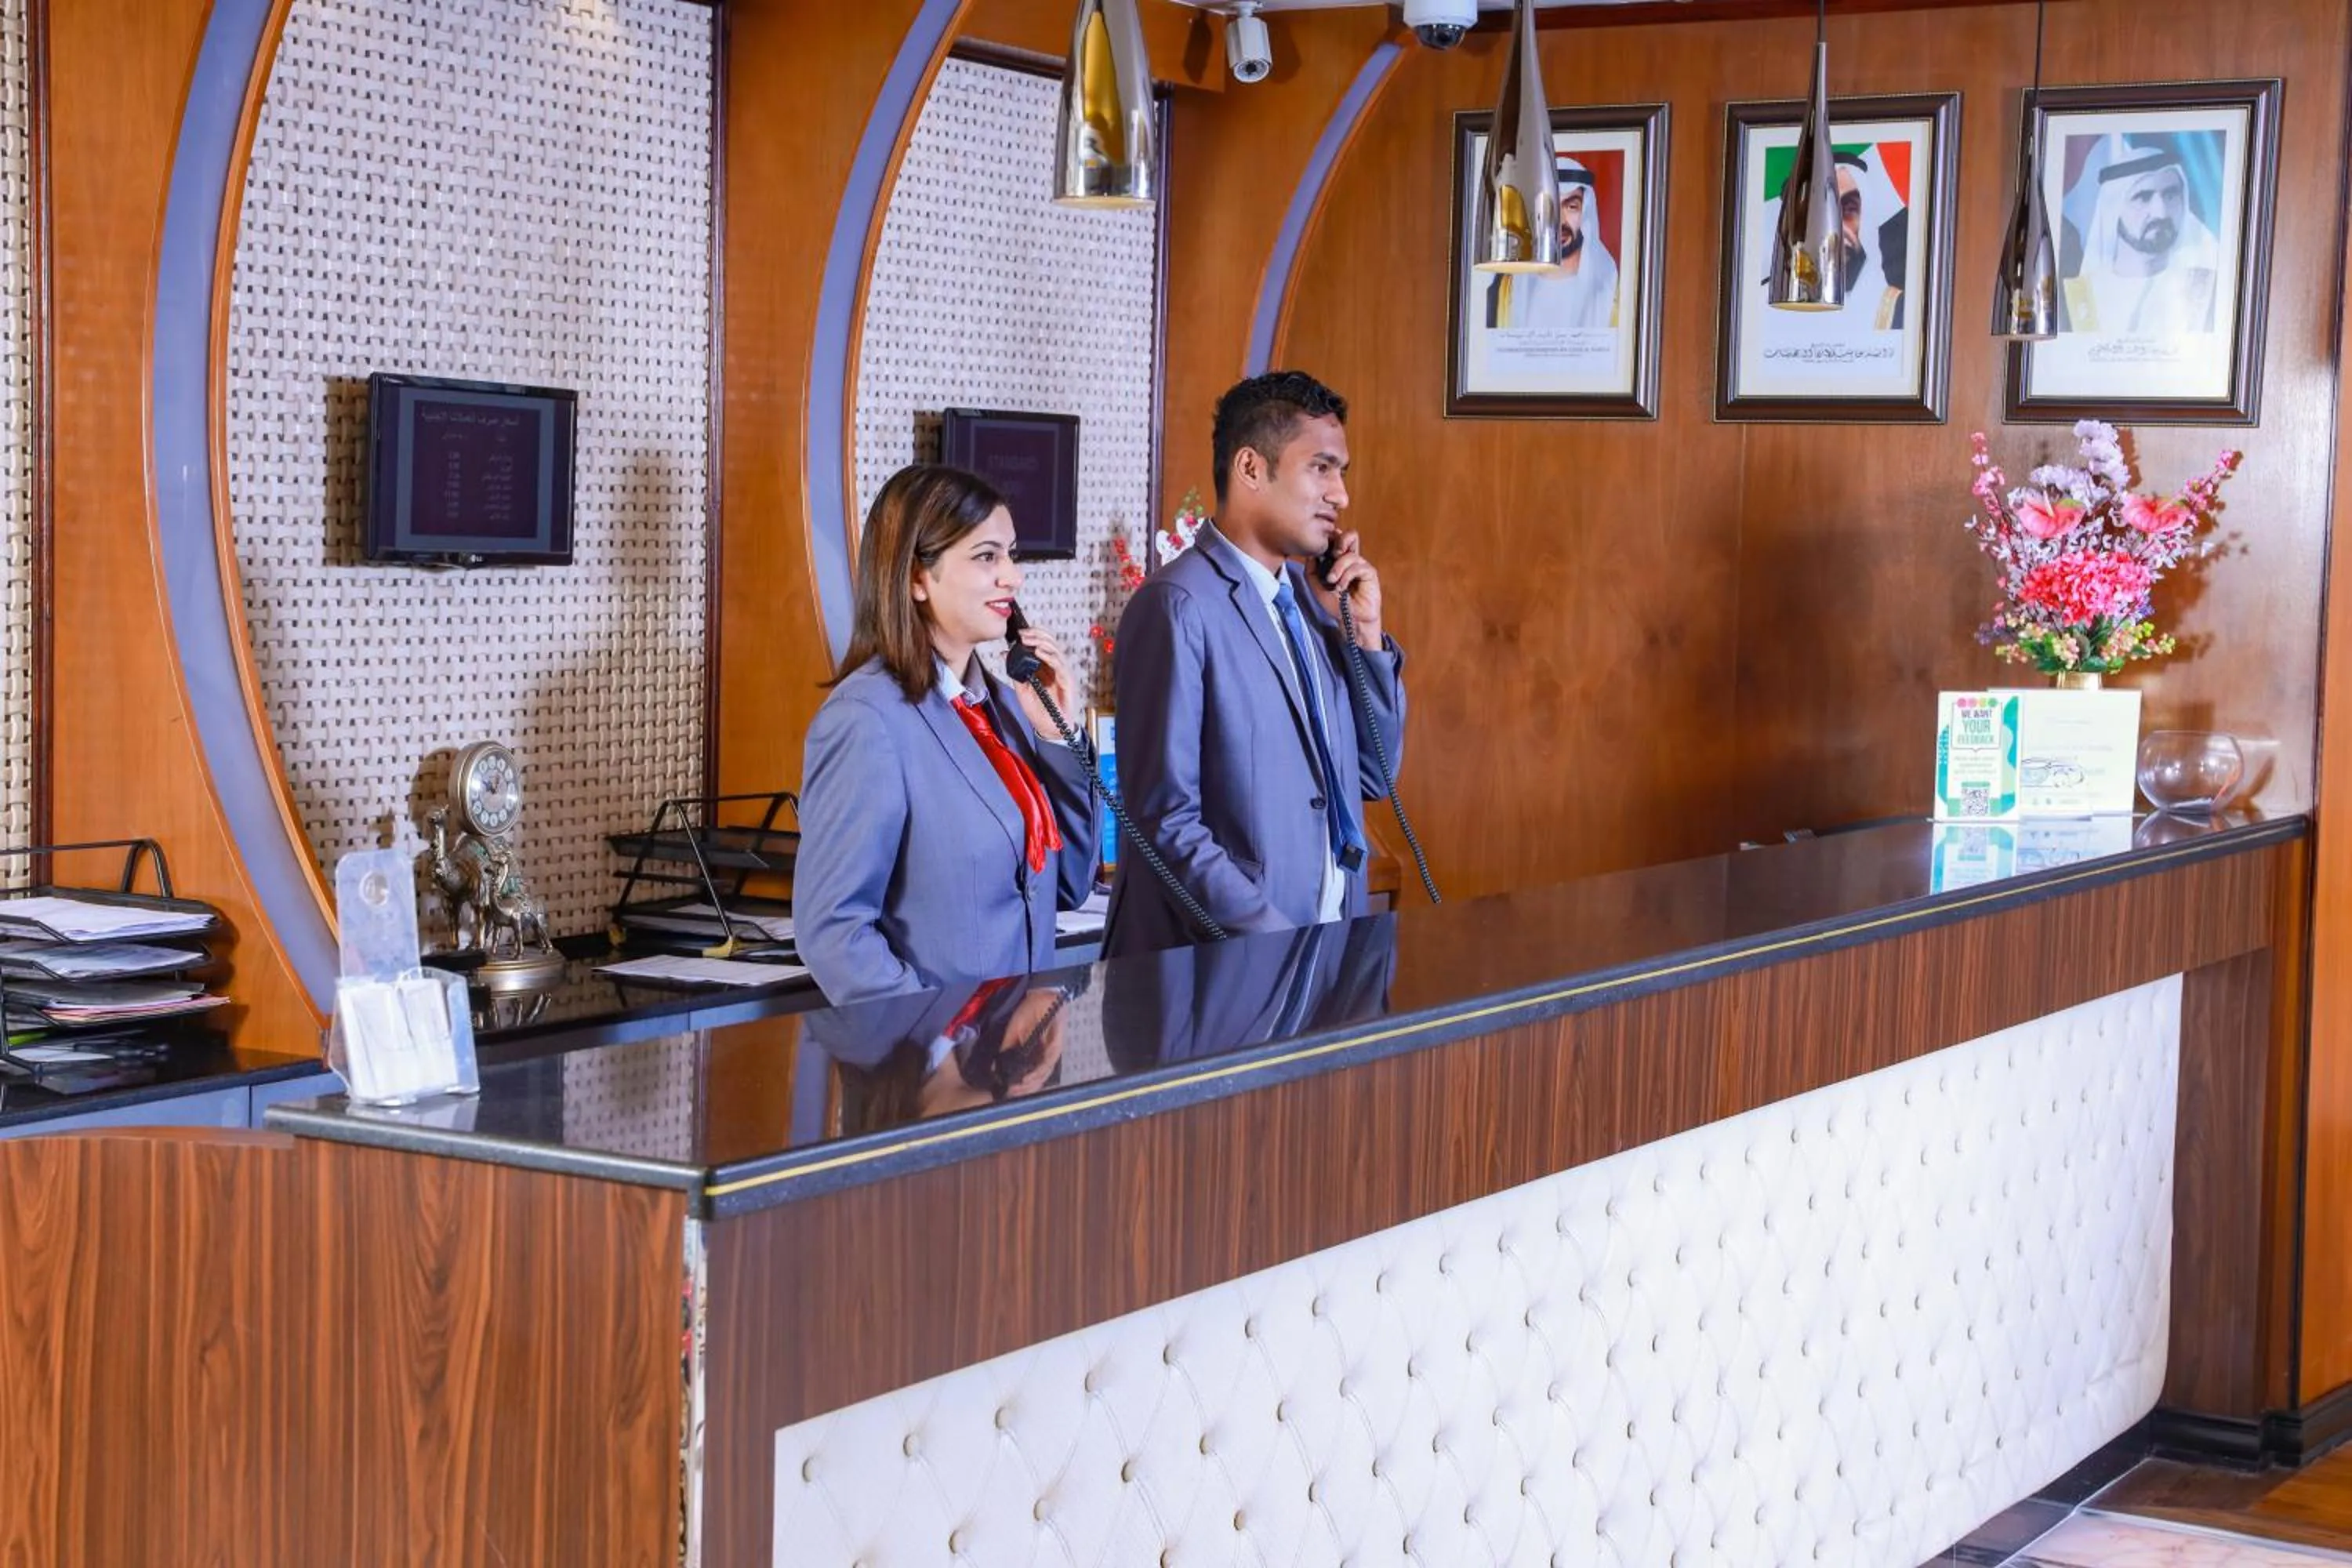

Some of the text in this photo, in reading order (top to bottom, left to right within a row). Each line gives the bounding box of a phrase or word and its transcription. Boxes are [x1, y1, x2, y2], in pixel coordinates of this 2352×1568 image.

[1961, 709, 1992, 718] WE WANT
[1962, 719, 1991, 733] YOUR
